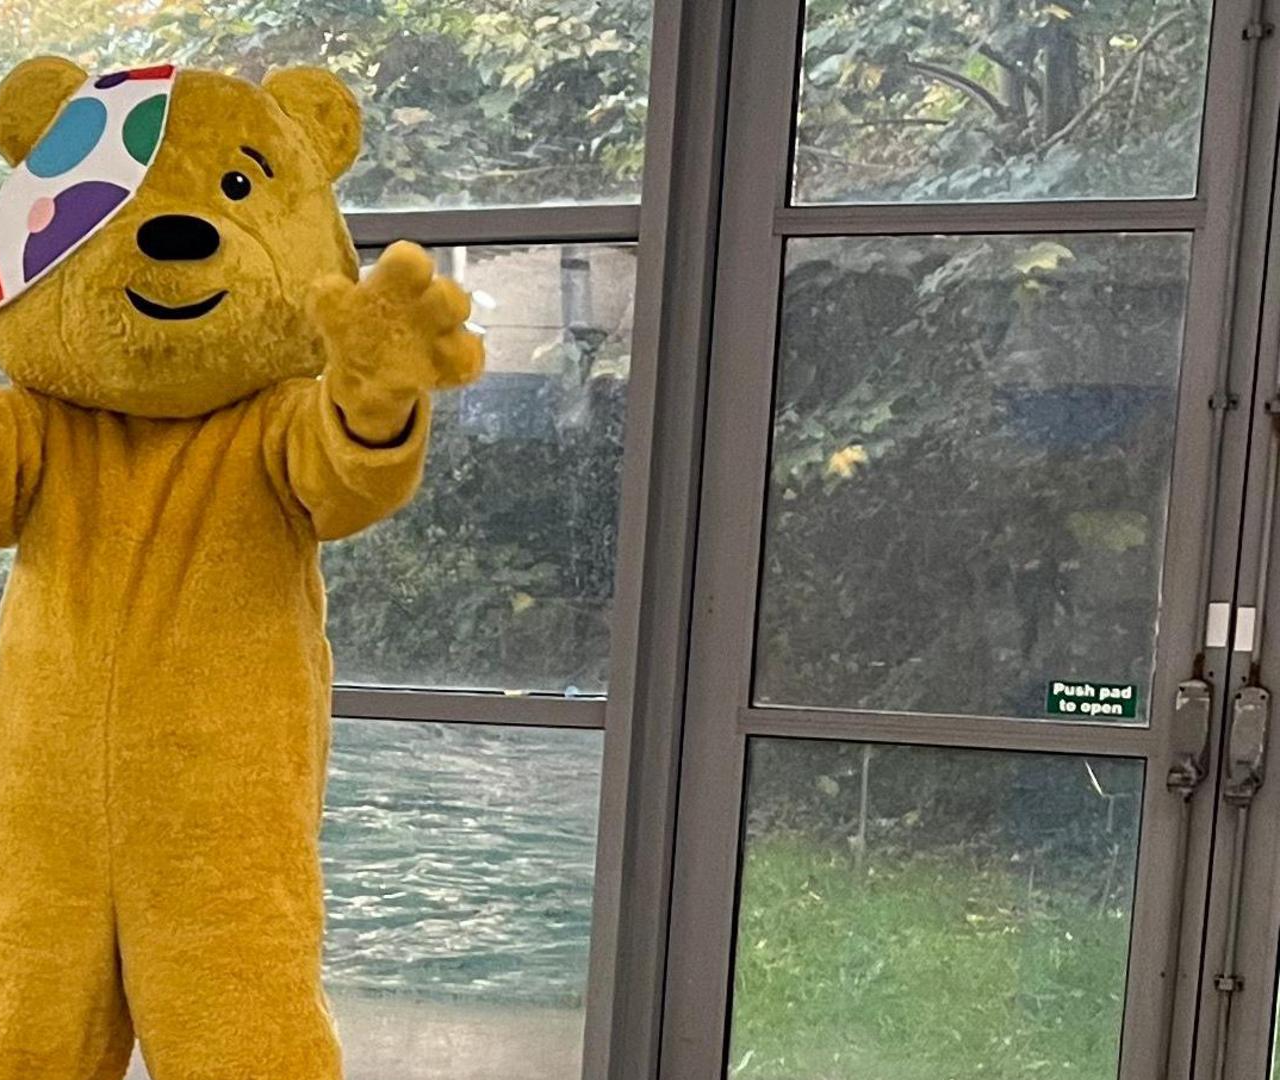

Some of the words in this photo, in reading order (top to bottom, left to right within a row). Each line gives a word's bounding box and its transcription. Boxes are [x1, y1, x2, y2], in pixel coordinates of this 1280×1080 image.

[1053, 682, 1095, 697] Push
[1099, 685, 1132, 700] pad
[1059, 699, 1076, 712] to
[1080, 702, 1123, 716] open
